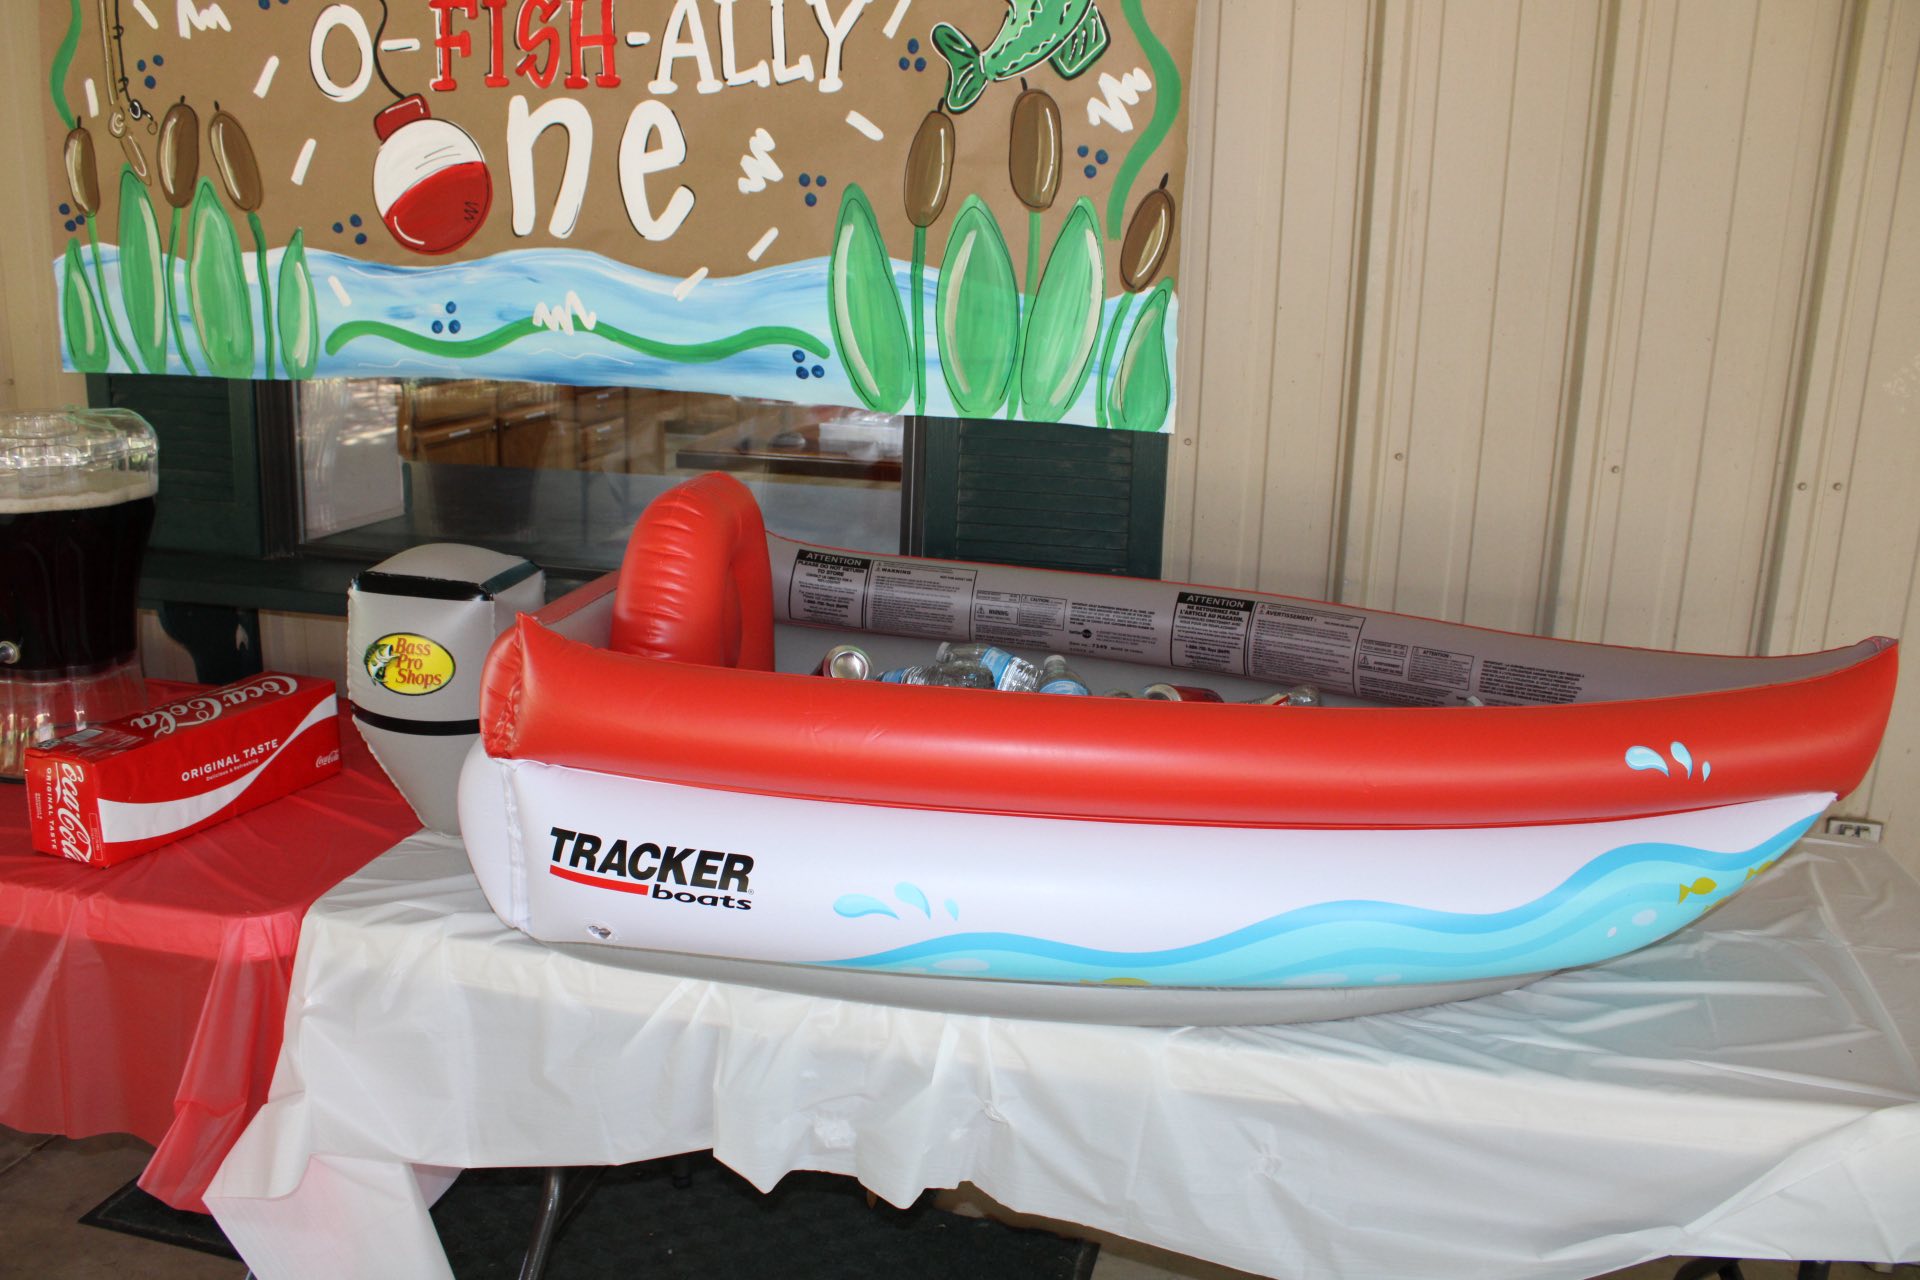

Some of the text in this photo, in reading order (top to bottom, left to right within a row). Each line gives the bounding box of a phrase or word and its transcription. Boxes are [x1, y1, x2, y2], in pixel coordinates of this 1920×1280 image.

[806, 552, 862, 566] ATTENTION
[1186, 595, 1245, 609] ATTENTION
[1180, 609, 1207, 618] L'ARTICLE
[1265, 610, 1314, 622] AVERTISSEMENT
[395, 638, 431, 656] Bass
[396, 654, 423, 670] Pro
[395, 668, 442, 689] Shops
[181, 738, 279, 782] ORIGINAL TASTE
[46, 767, 58, 850] ORIGINAL TASTE
[550, 826, 755, 893] TRACKER
[652, 884, 752, 910] boats
